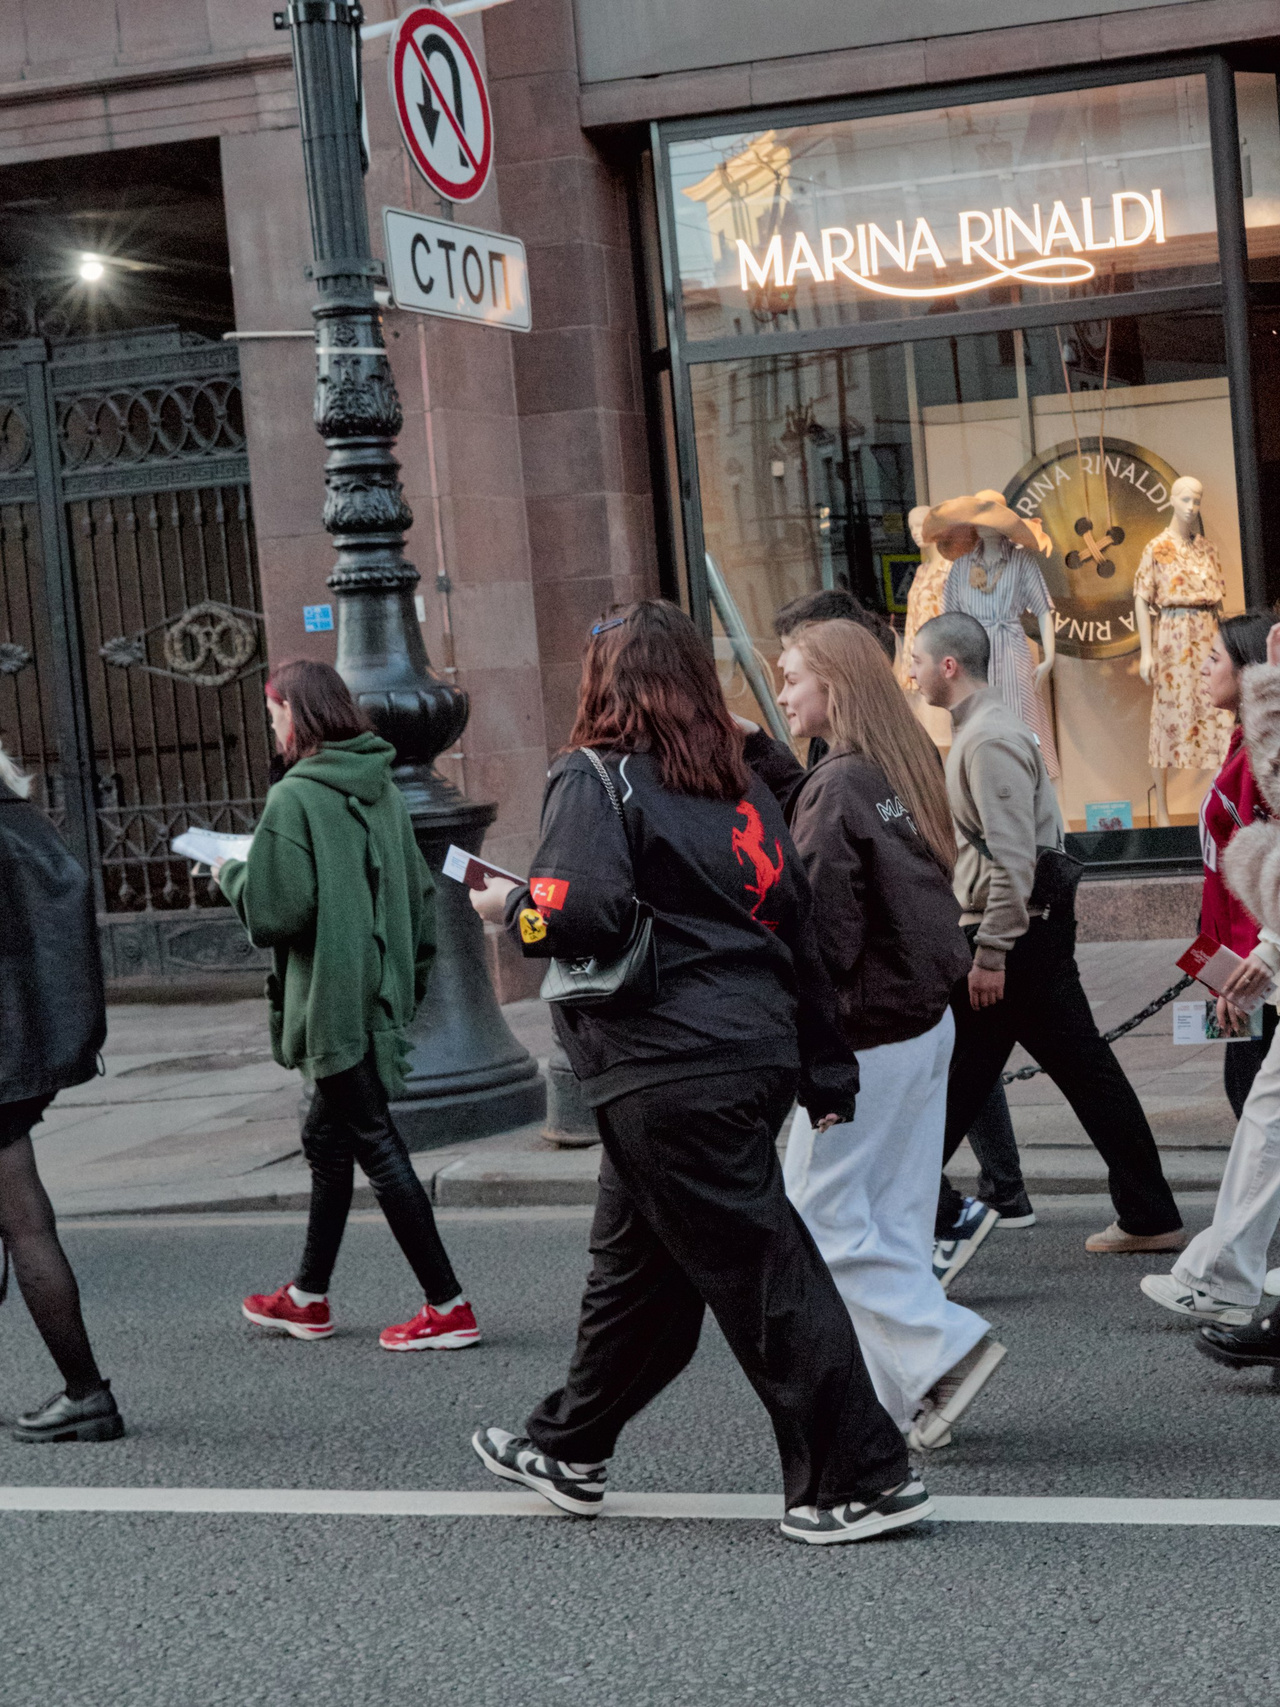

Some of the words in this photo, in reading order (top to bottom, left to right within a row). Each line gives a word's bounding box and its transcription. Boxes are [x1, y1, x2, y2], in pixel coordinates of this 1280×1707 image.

[410, 232, 512, 311] СТОП
[735, 217, 948, 298] MARINA
[958, 188, 1166, 284] RINALDI
[1015, 464, 1072, 518] RINA
[1081, 454, 1176, 513] RINALDI
[1054, 609, 1112, 642] RINA
[532, 883, 556, 902] F-1
